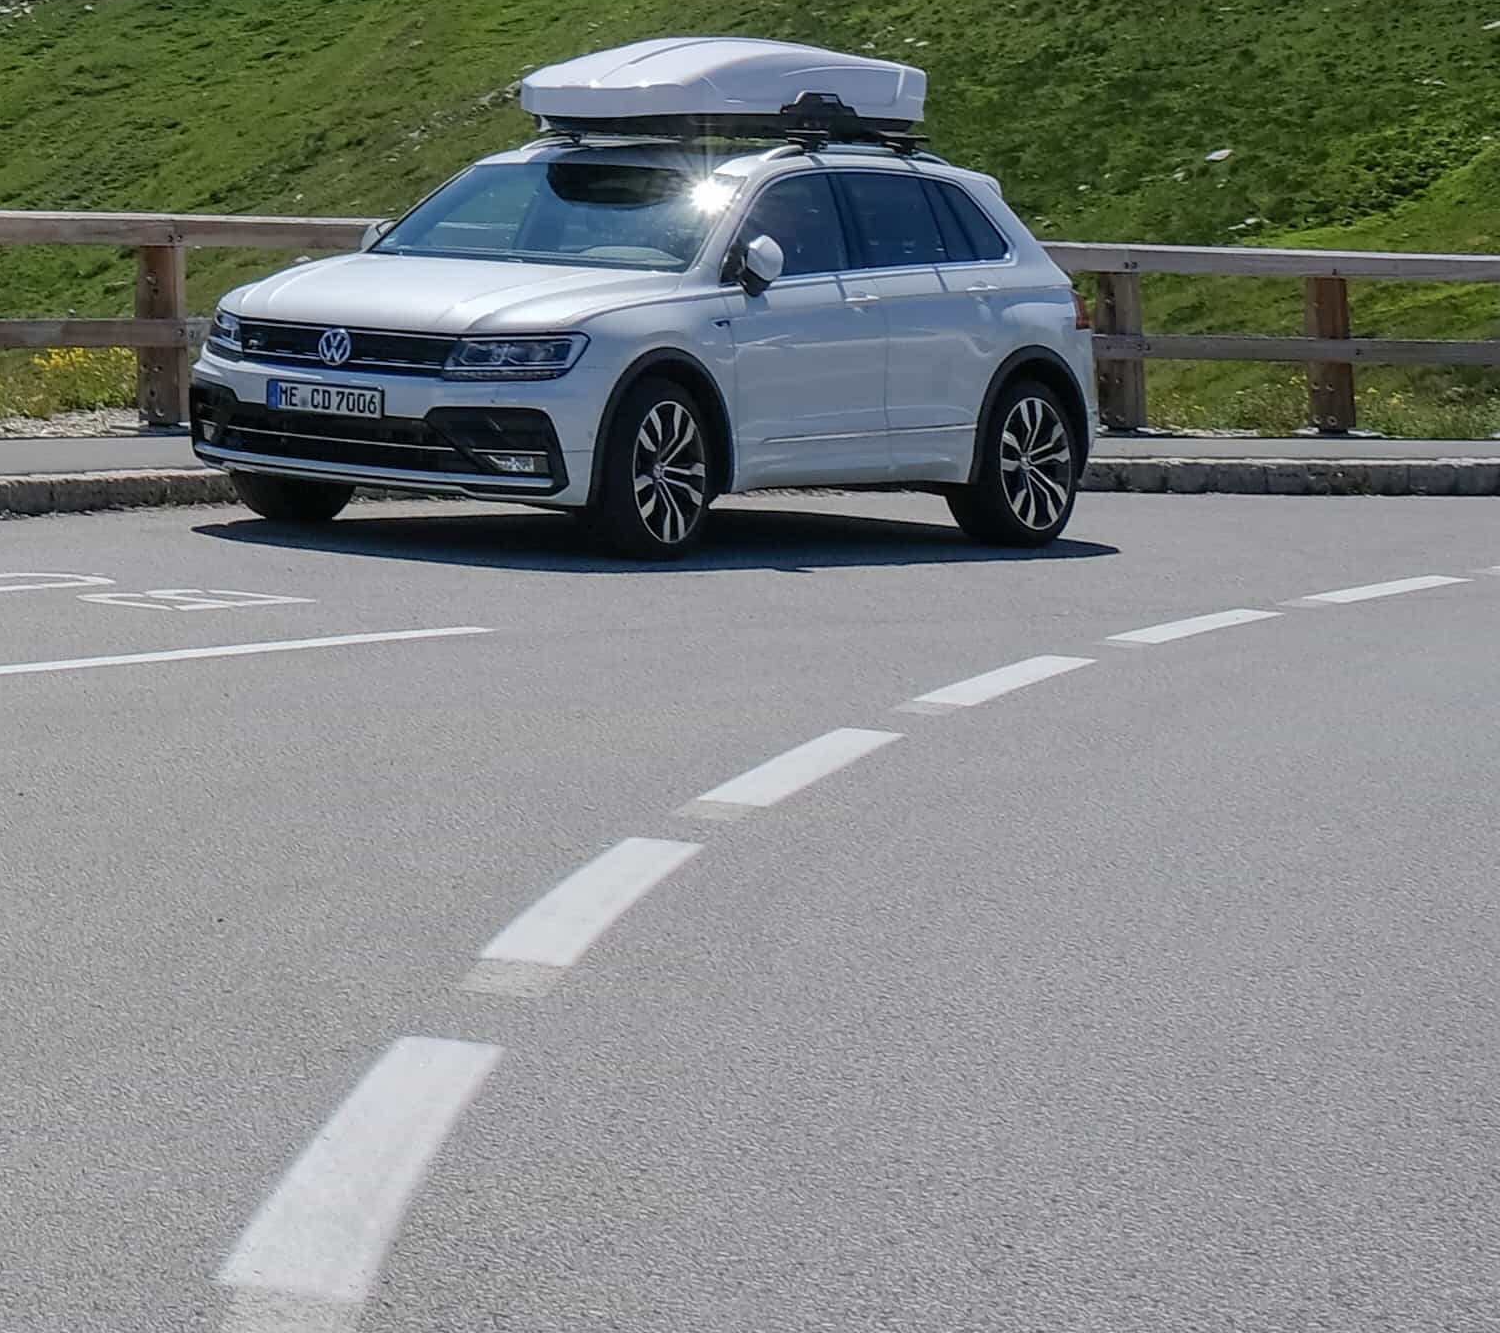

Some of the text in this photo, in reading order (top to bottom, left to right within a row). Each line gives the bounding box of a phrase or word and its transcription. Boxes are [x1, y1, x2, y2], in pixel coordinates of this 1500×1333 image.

[279, 386, 377, 414] ME CD 7006
